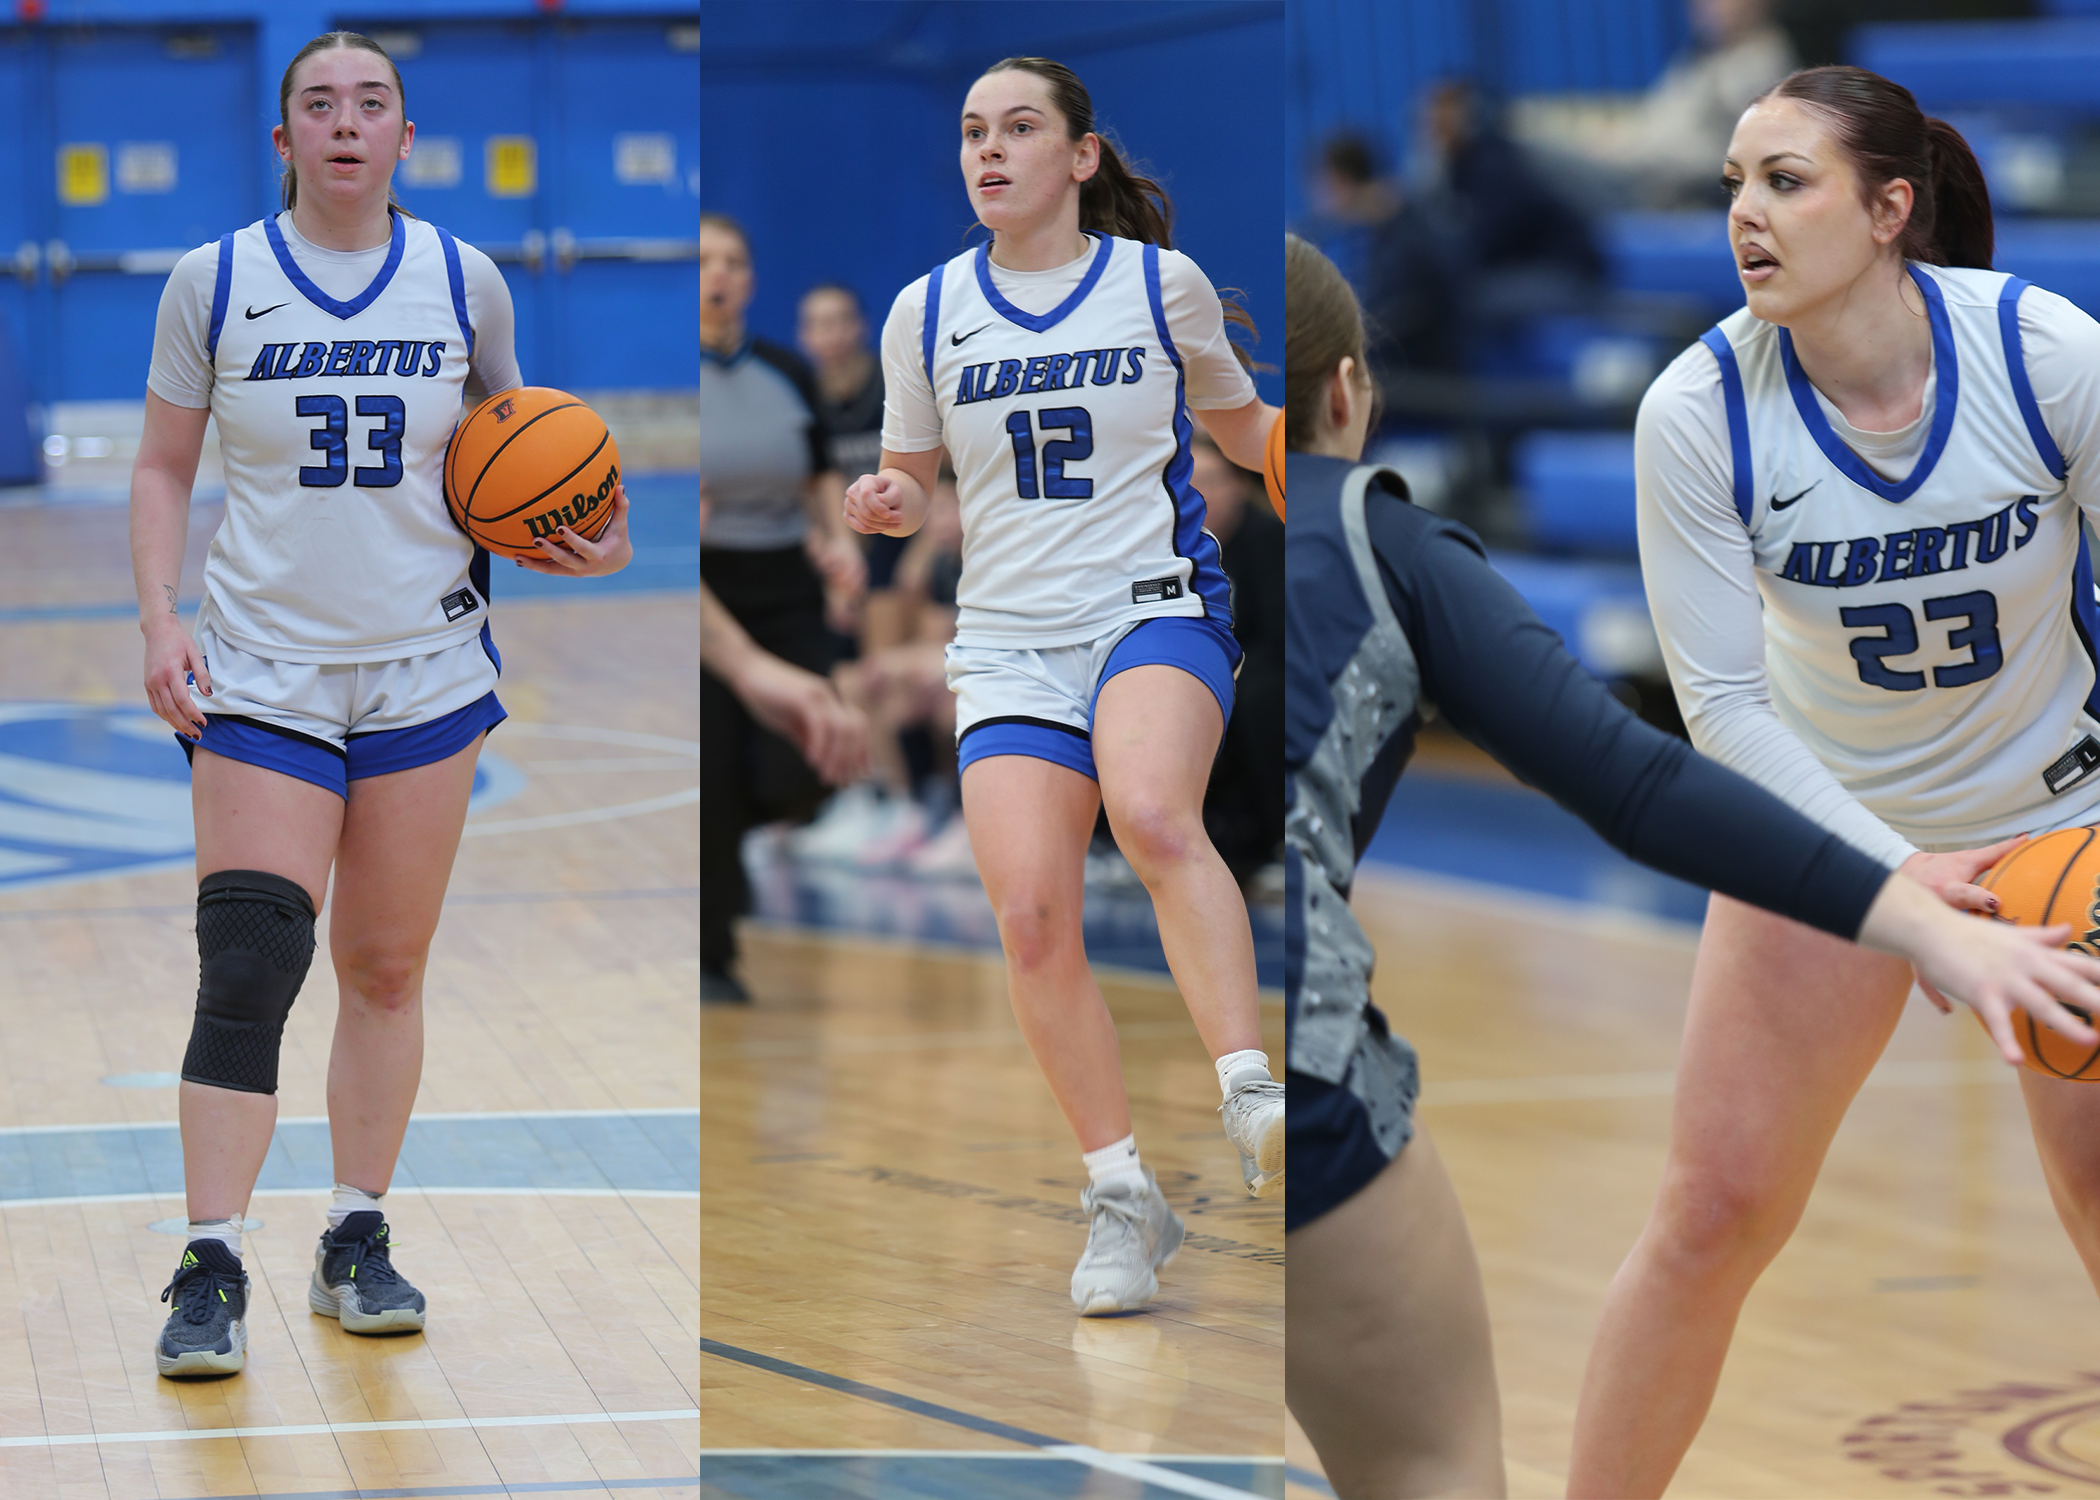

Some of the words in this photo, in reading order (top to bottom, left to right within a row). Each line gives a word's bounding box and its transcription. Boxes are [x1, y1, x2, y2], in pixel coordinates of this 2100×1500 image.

[243, 340, 446, 381] ALBERTUS
[953, 347, 1146, 406] ALBERTUS
[295, 394, 406, 488] 33
[1006, 406, 1094, 499] 12
[522, 464, 618, 538] Wilson
[1775, 495, 2039, 589] ALBERTUS
[464, 595, 473, 605] L
[1166, 585, 1177, 596] M
[1839, 589, 2004, 692] 23
[2083, 750, 2097, 763] L
